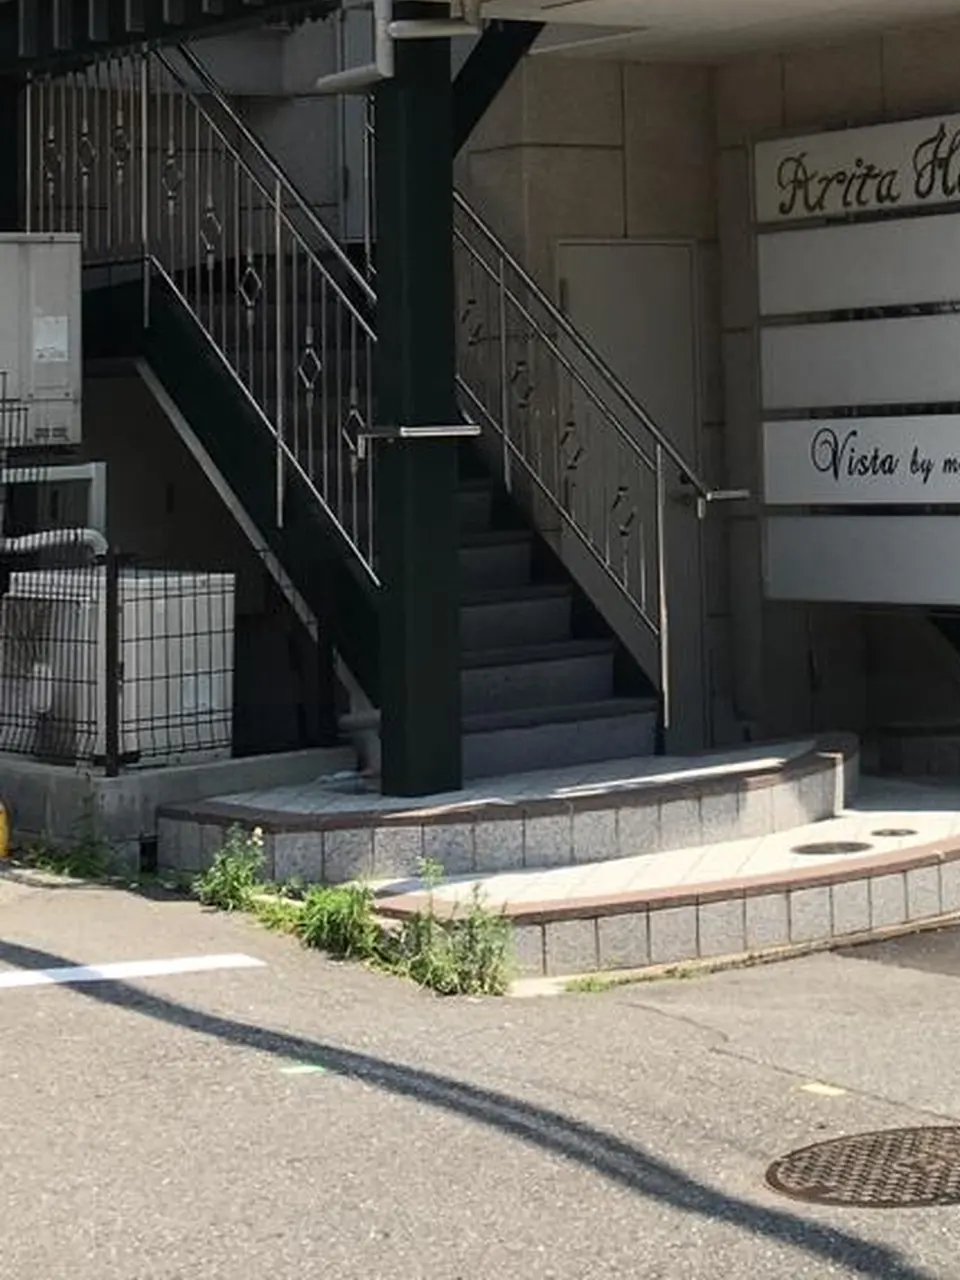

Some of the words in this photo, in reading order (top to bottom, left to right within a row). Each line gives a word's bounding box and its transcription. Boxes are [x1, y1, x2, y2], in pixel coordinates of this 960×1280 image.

[777, 152, 900, 214] Arita
[811, 427, 899, 481] Vista
[909, 445, 935, 484] by
